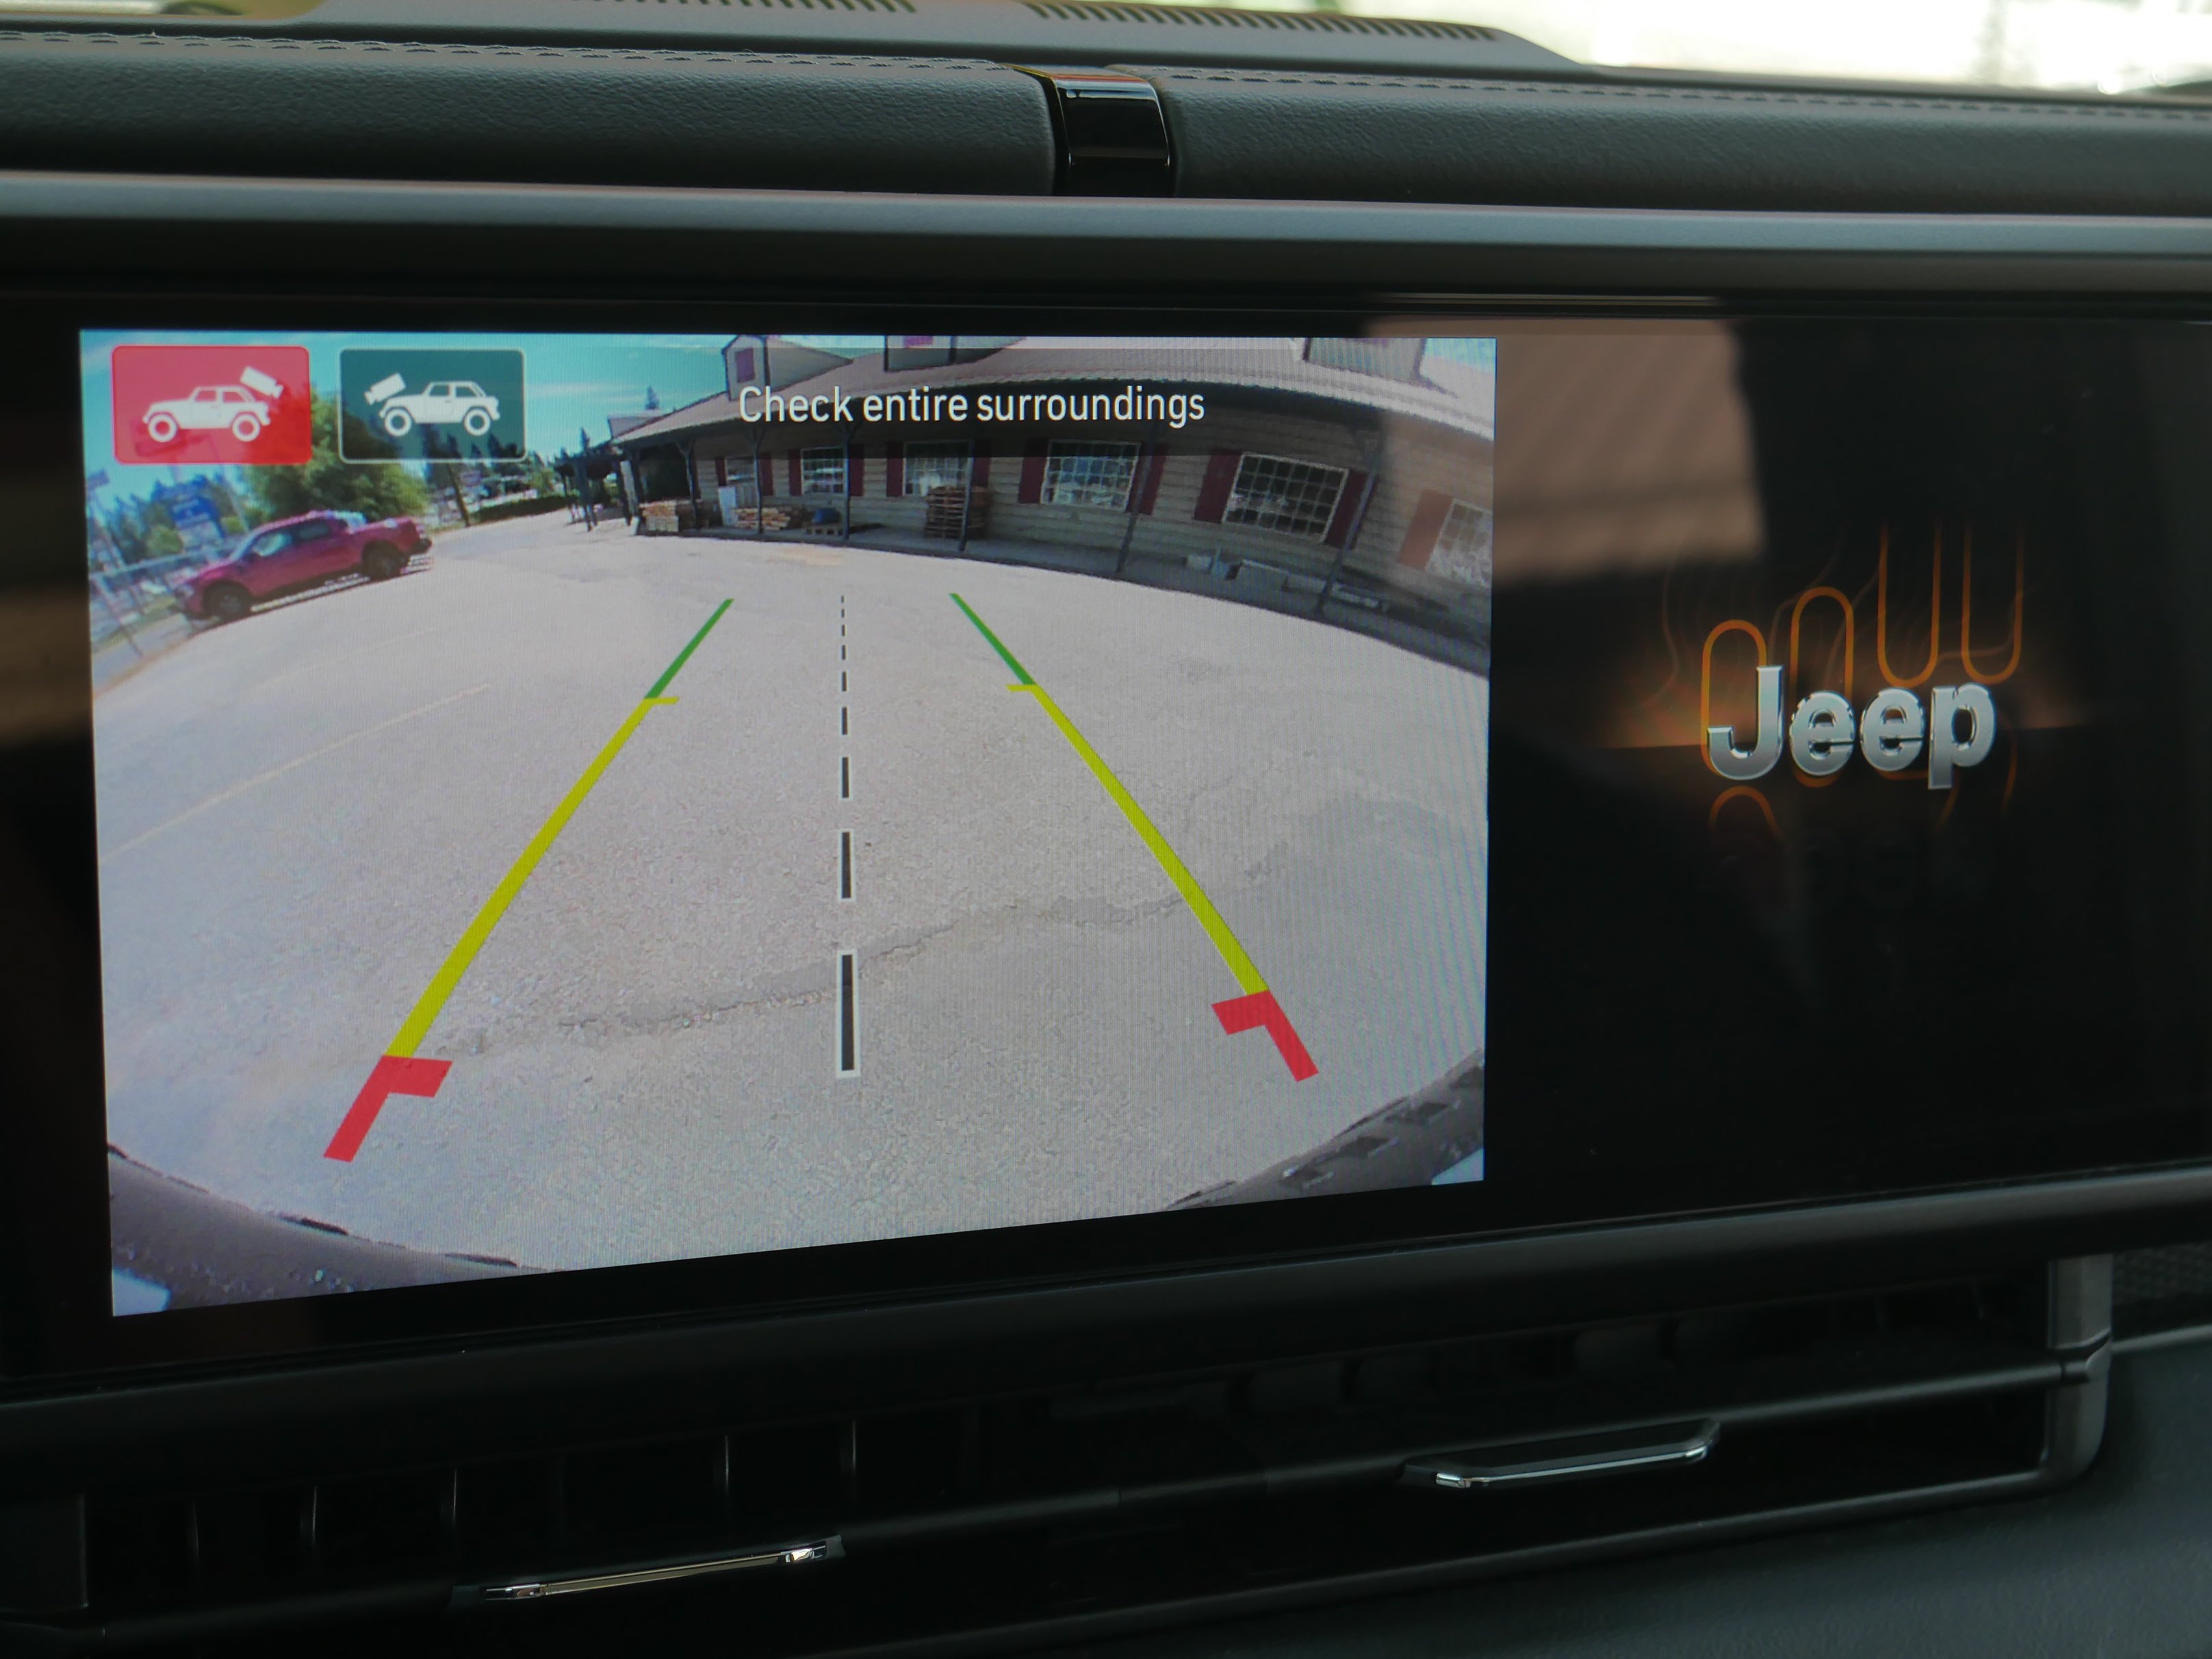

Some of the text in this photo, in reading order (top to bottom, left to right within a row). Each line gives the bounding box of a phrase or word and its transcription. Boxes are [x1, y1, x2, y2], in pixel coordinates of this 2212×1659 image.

[738, 385, 1205, 428] Check entire surroundings
[1706, 665, 1997, 790] Jeep
